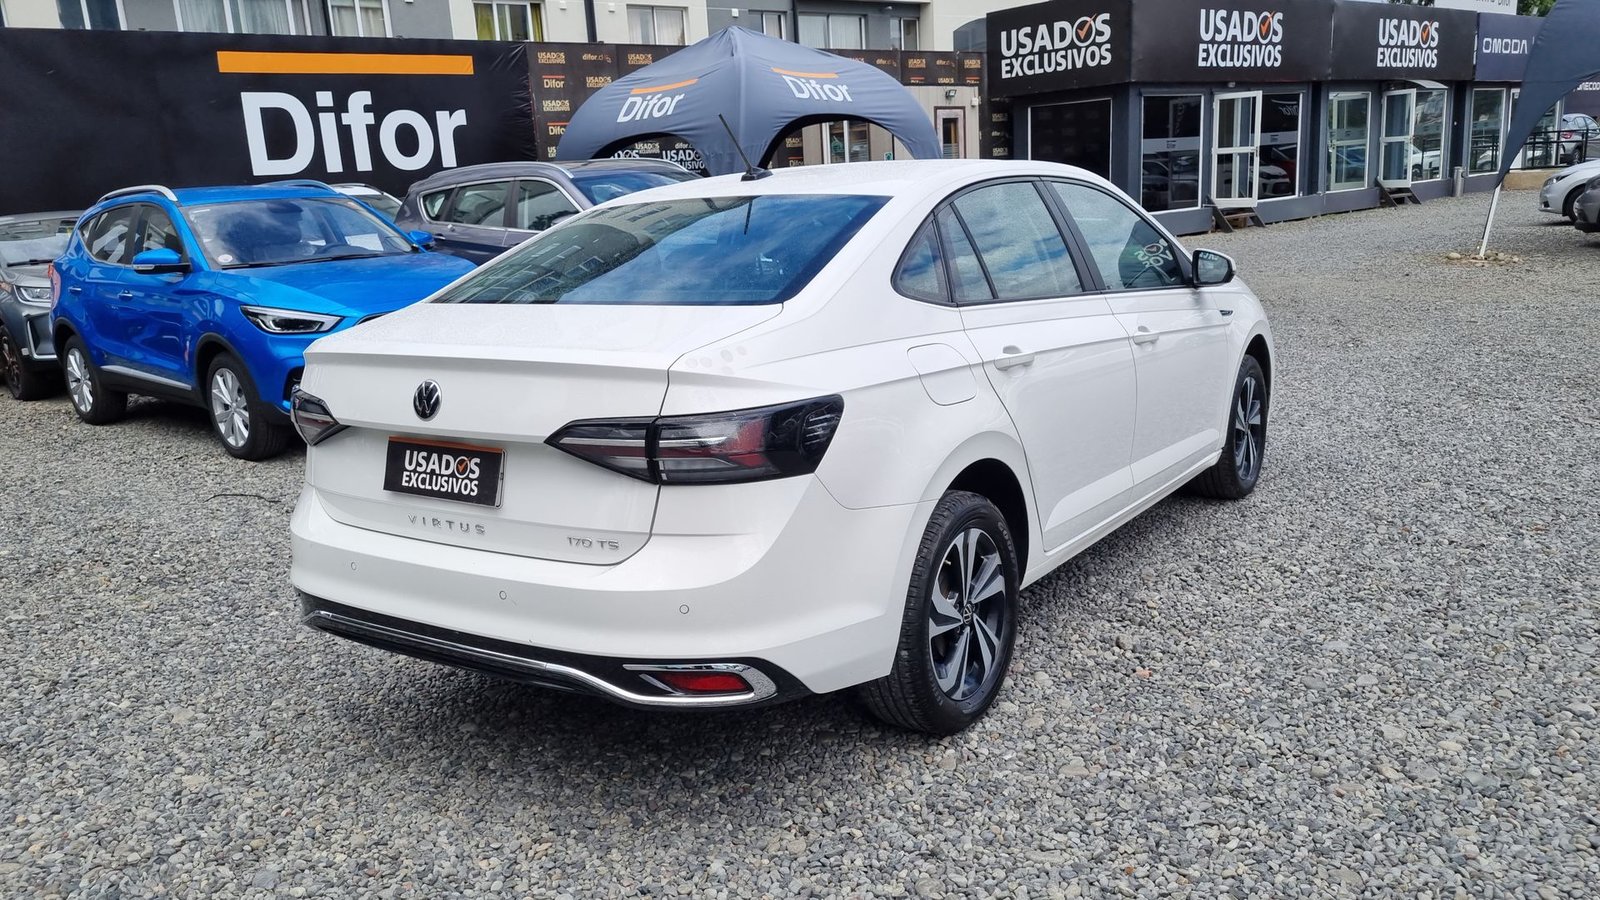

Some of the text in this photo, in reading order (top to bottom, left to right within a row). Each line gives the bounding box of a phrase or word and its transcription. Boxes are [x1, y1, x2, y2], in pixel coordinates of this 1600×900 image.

[1000, 13, 1111, 57] USADOS
[1200, 9, 1283, 44] USADOS
[1378, 18, 1439, 48] USADOS
[1198, 43, 1282, 67] EXCLUSIVOS
[1377, 47, 1438, 68] EXCLUSIVOS
[1482, 37, 1528, 54] OMODA
[1001, 43, 1112, 79] EXCLUSIVOS
[543, 79, 564, 88] Difor
[781, 75, 853, 102] Difor
[542, 99, 569, 107] USADOS
[616, 93, 685, 123] Difor
[241, 90, 467, 176] Difor
[548, 126, 566, 135] Difo
[404, 450, 481, 479] USADOS
[402, 471, 479, 497] EXCLUSIVOS
[408, 514, 486, 535] VIRTUS
[567, 536, 619, 550] 170 TS
